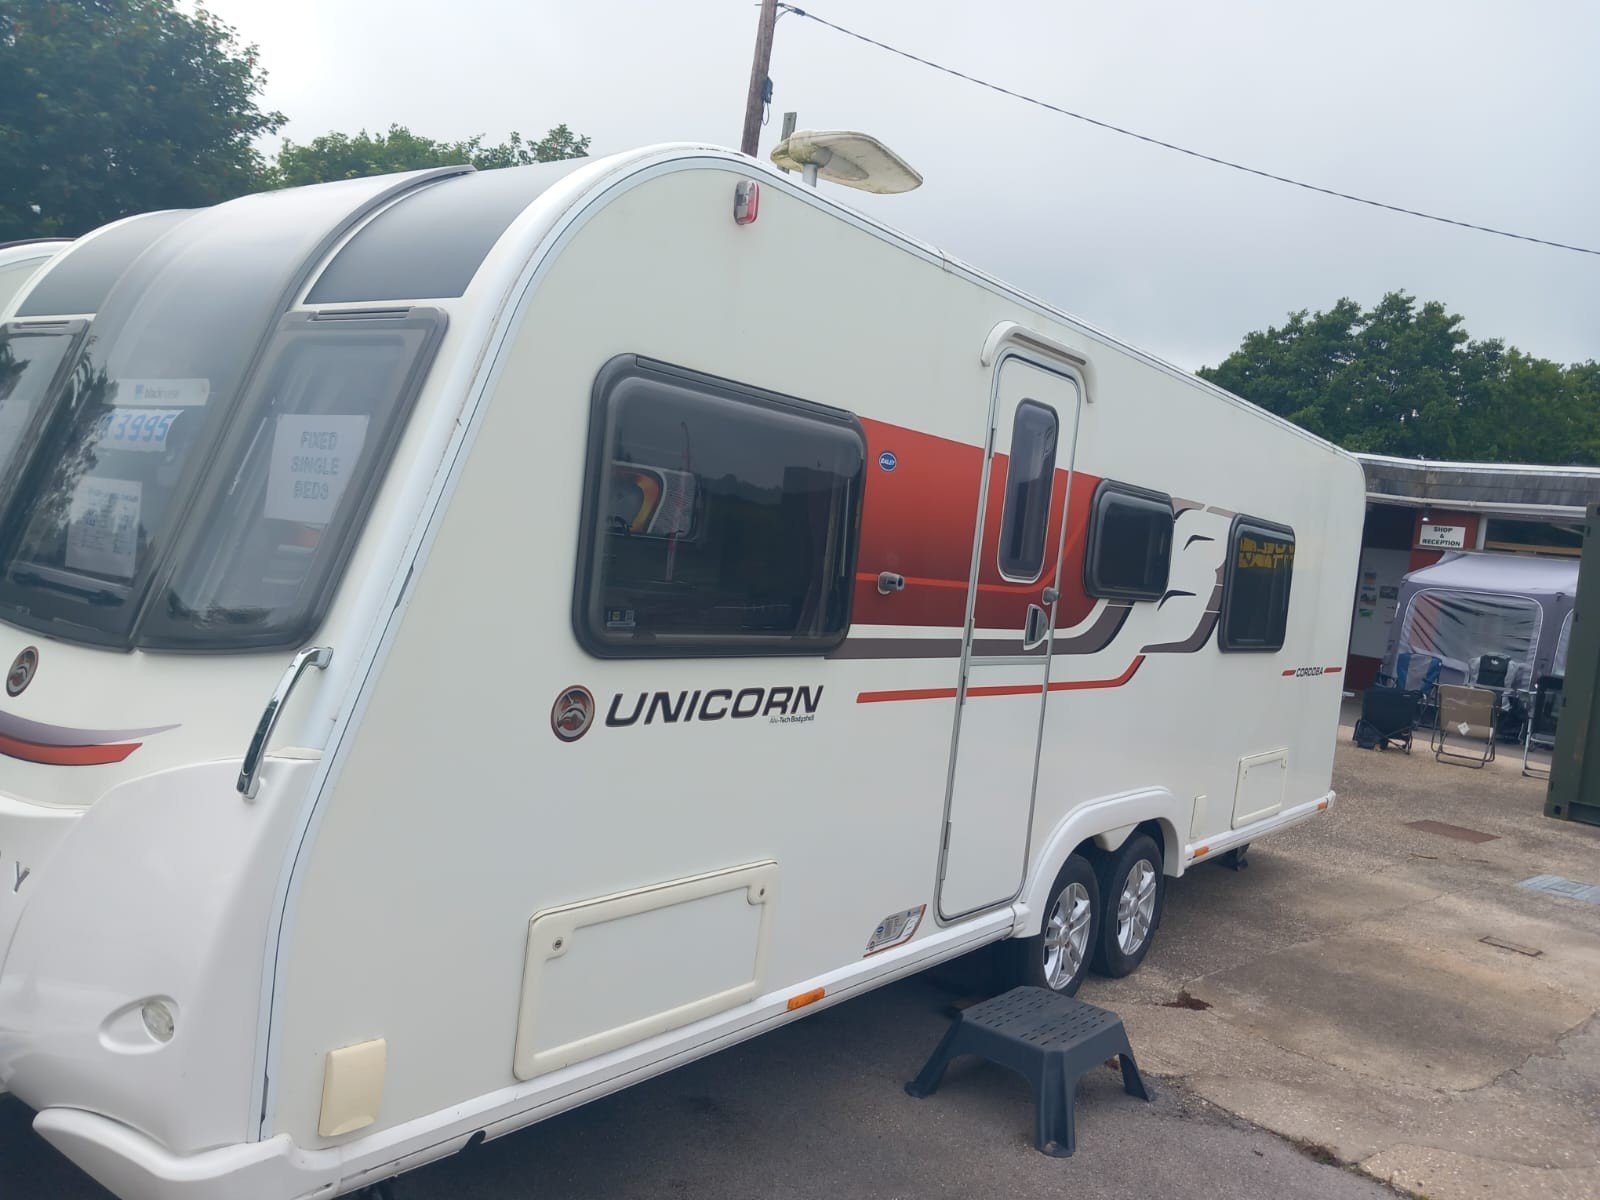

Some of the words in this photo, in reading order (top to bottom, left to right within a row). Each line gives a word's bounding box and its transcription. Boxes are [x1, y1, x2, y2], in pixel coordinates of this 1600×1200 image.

[301, 431, 338, 450] FIXED
[290, 455, 340, 475] SINGLE
[1421, 538, 1462, 547] RECEPTION
[1295, 666, 1324, 678] CORDOBA
[605, 685, 824, 727] UNICORN
